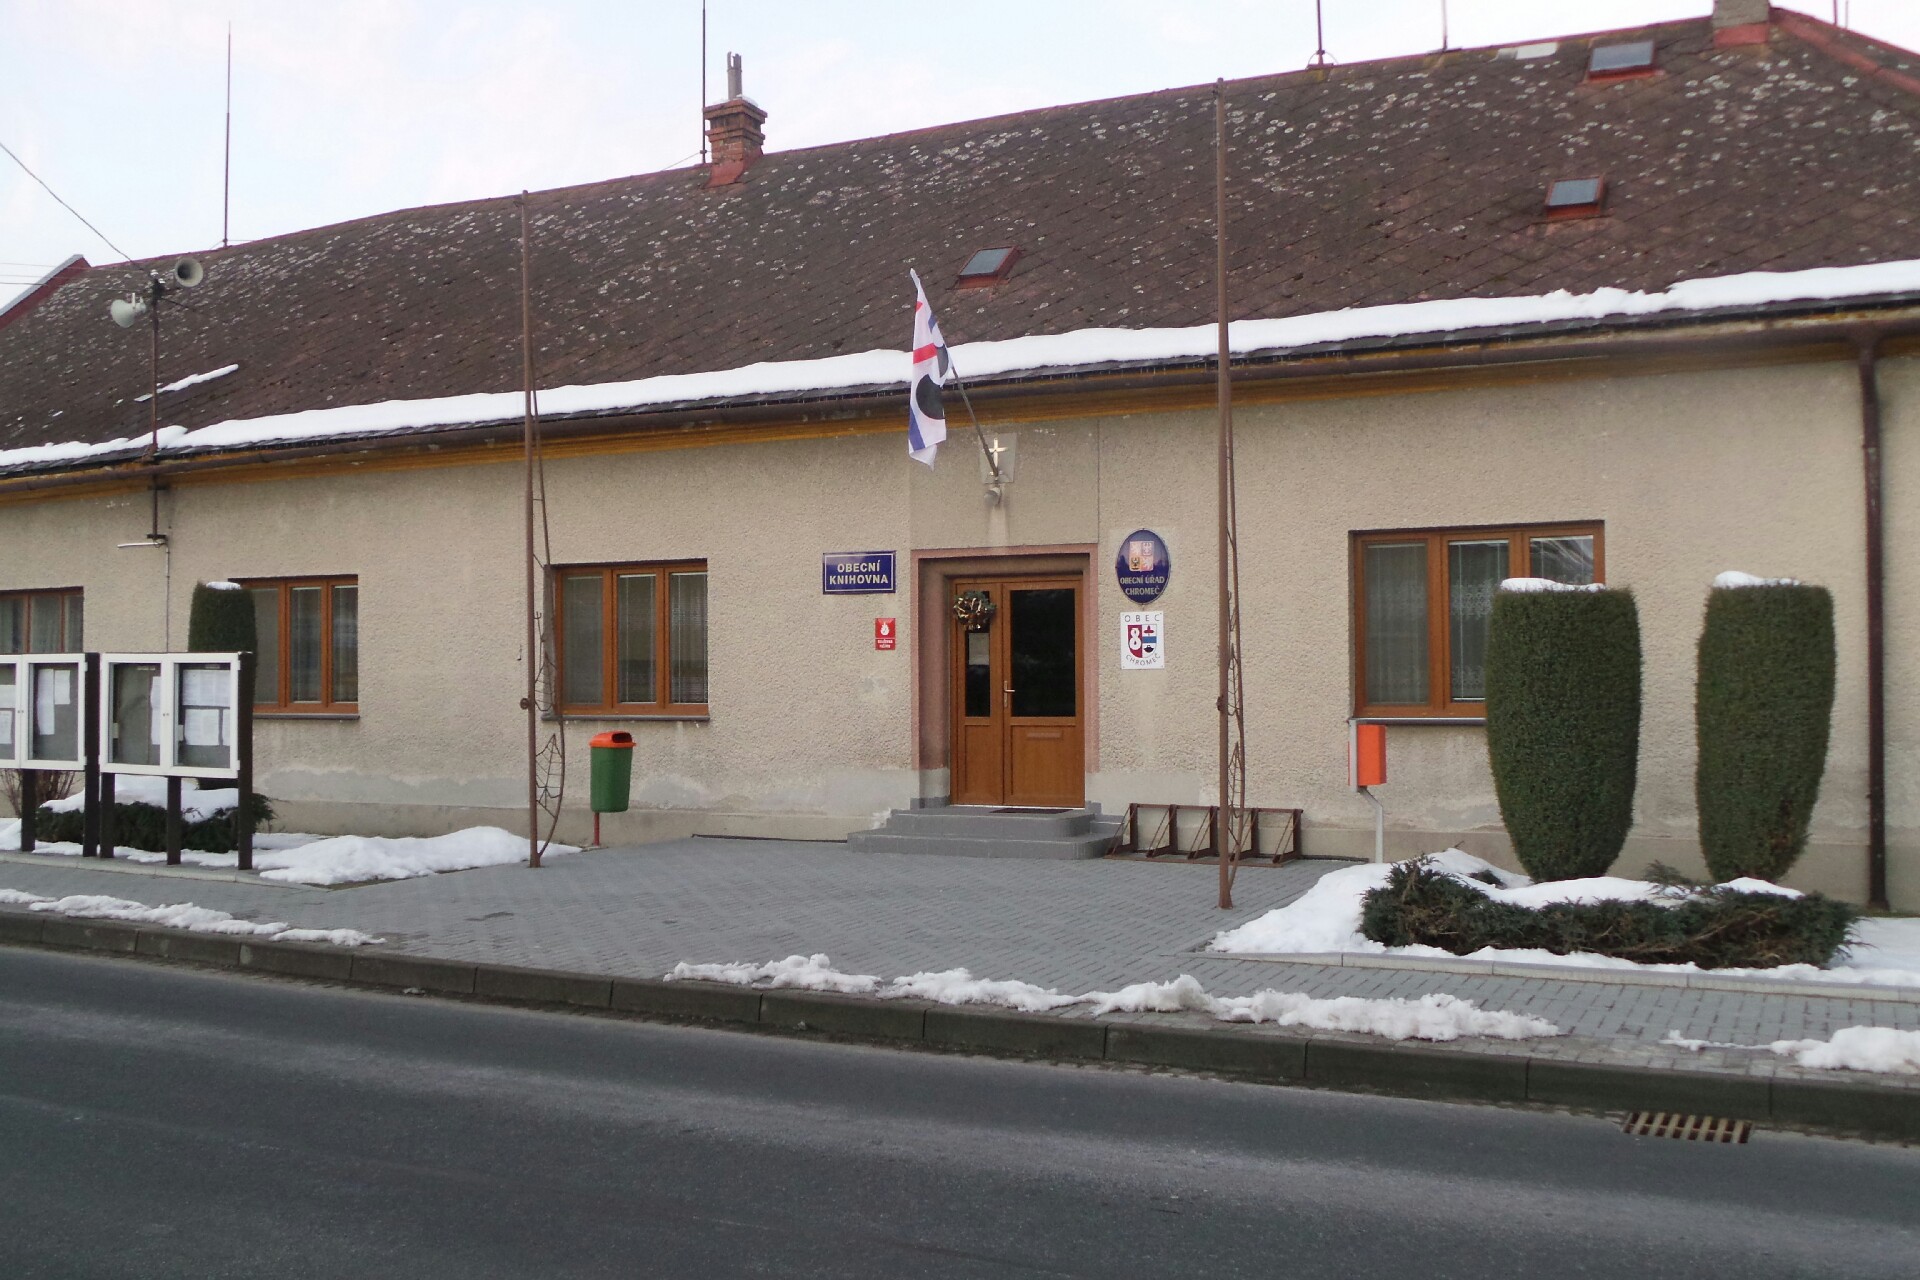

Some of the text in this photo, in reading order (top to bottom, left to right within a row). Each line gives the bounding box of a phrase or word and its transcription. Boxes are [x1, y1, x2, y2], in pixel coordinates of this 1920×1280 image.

[837, 560, 880, 573] OBECNÍ
[829, 574, 888, 585] KNIHOVNA
[1119, 574, 1165, 585] OBECNÍ ÚŘAD
[1125, 586, 1160, 596] CHROMEČ
[1124, 614, 1161, 623] OBEC
[1125, 653, 1161, 666] CHROMEČ
